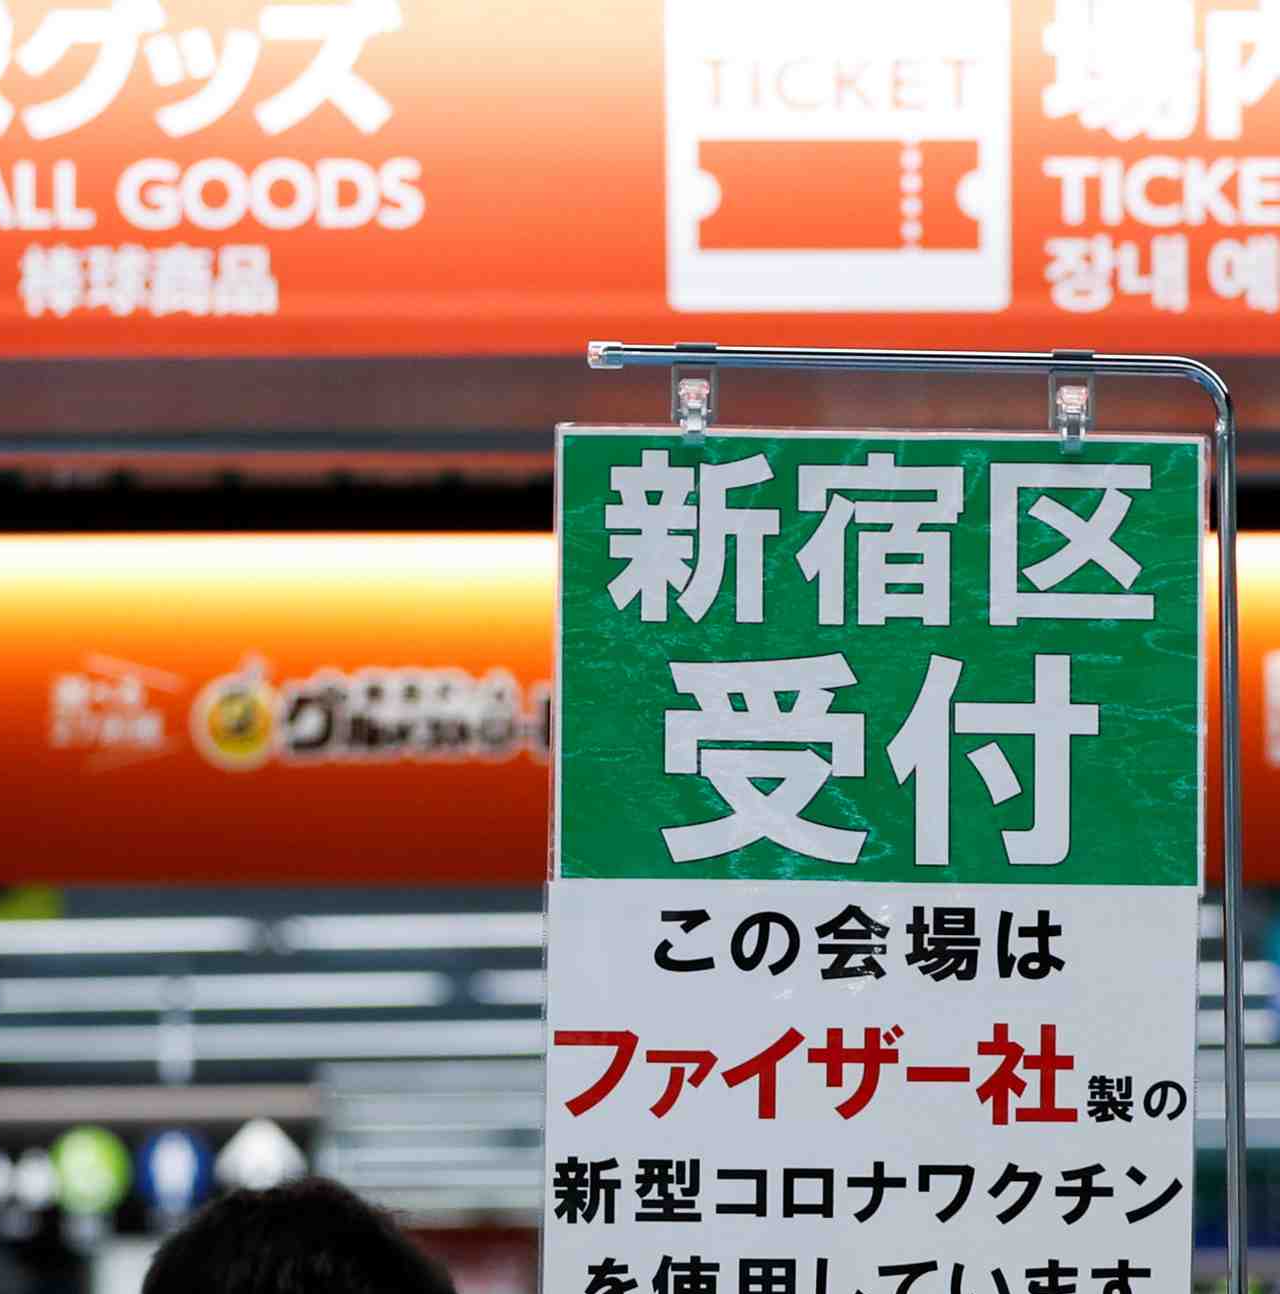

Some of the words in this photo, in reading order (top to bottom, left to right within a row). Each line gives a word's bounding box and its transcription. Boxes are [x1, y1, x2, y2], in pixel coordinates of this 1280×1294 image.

[704, 55, 979, 113] TICKET
[116, 156, 426, 231] GOODS
[1043, 234, 1191, 314] 장내
[604, 448, 1155, 627] 新宿区
[660, 651, 1101, 866] 受付
[653, 903, 1066, 983] この会場は
[553, 1022, 1188, 1126] ファイザー社製の
[552, 1156, 1184, 1226] 新型コロナワクチン
